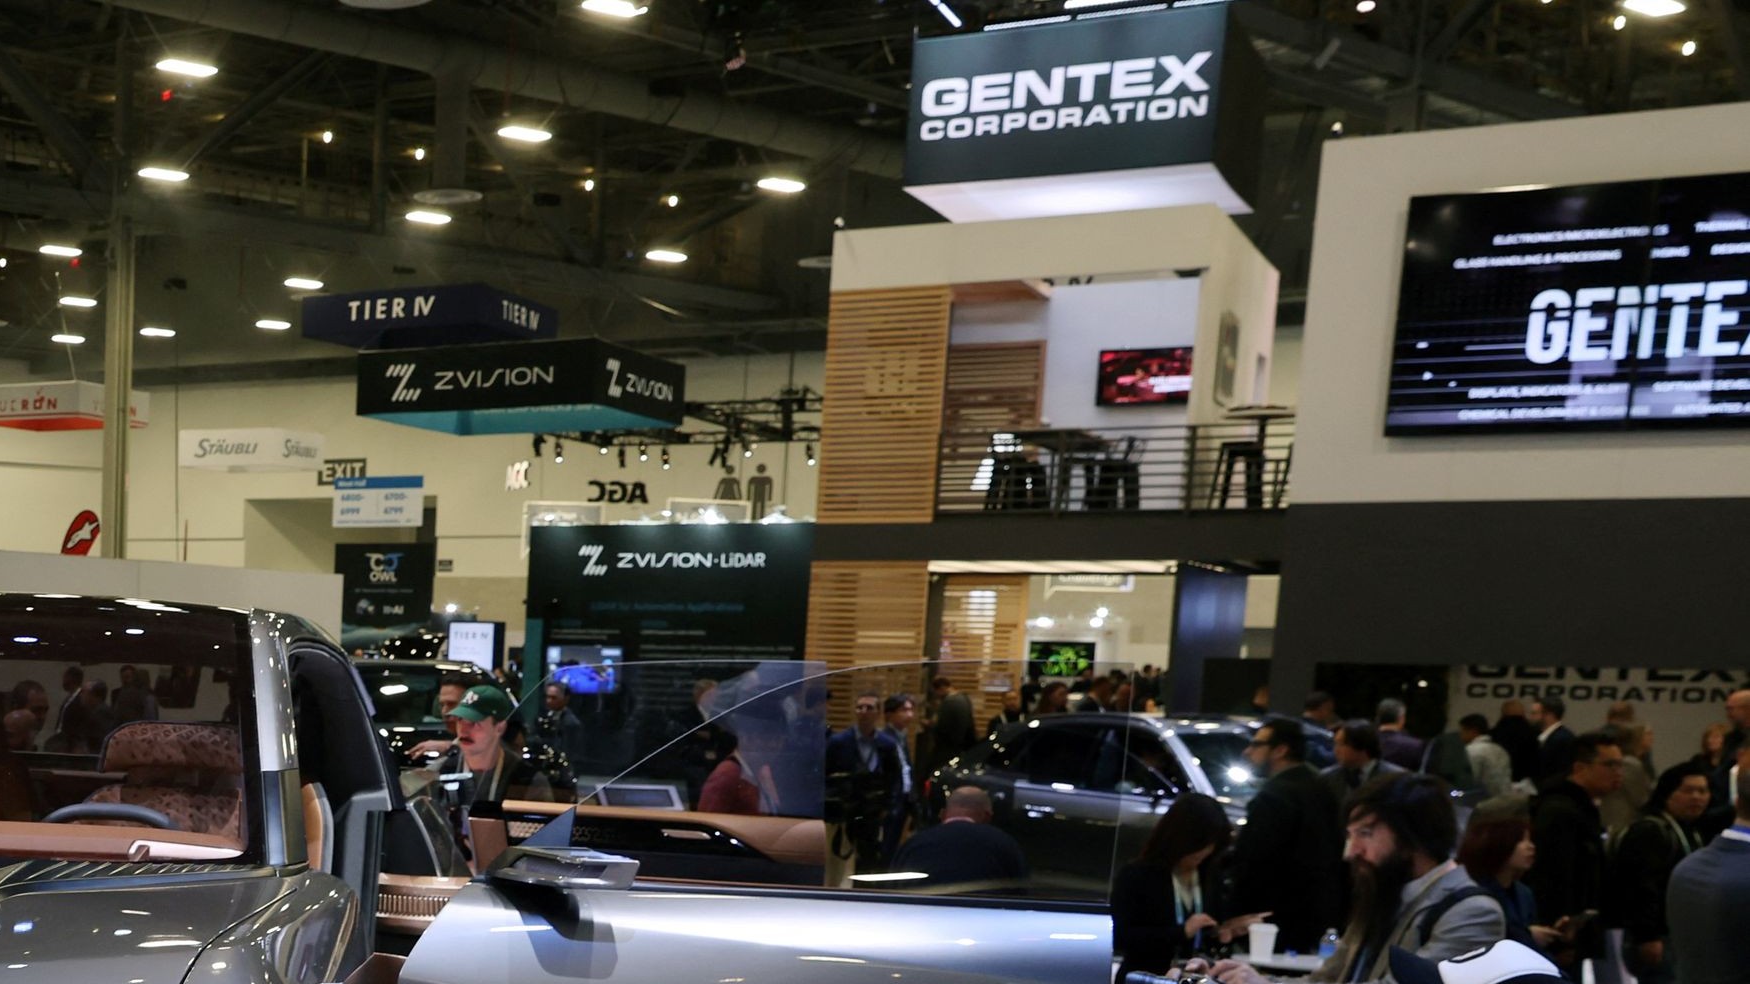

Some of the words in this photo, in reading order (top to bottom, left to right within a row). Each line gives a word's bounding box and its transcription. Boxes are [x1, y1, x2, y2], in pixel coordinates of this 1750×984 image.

[921, 50, 1213, 118] GENTEX
[919, 94, 1210, 142] CORPORATION
[348, 298, 406, 322] TIER
[501, 300, 528, 327] TIER
[1524, 280, 1750, 364] GENTE
[433, 365, 555, 391] ZVISION
[625, 372, 674, 402] ZVISION
[322, 461, 365, 481] EXIT
[1465, 682, 1734, 704] CORPORATION
